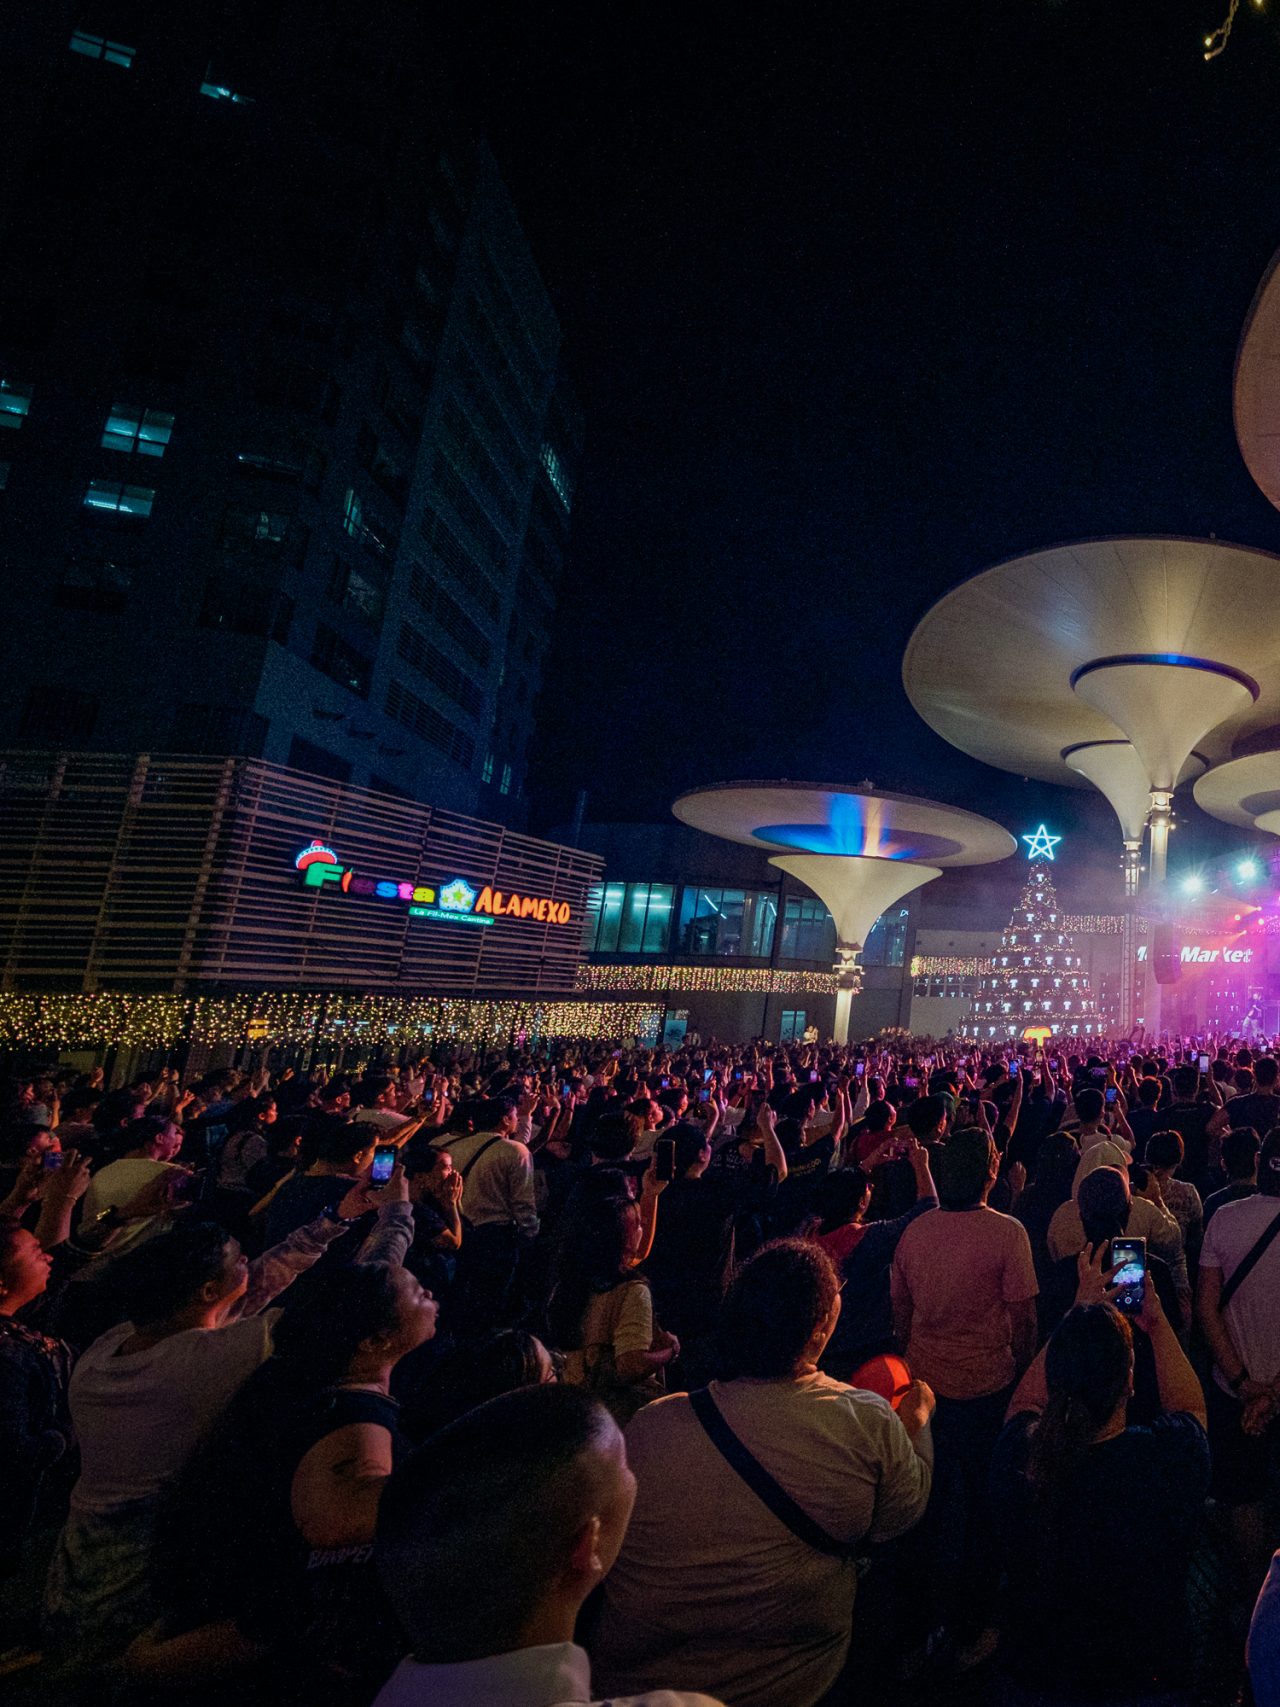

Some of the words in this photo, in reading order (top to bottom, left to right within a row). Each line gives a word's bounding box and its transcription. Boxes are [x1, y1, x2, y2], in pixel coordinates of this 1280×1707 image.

[305, 862, 435, 903] Fiesta
[475, 886, 570, 924] ALAMEXO
[414, 908, 425, 916] La
[427, 909, 459, 920] Fil-Mex
[460, 914, 491, 925] Cantina
